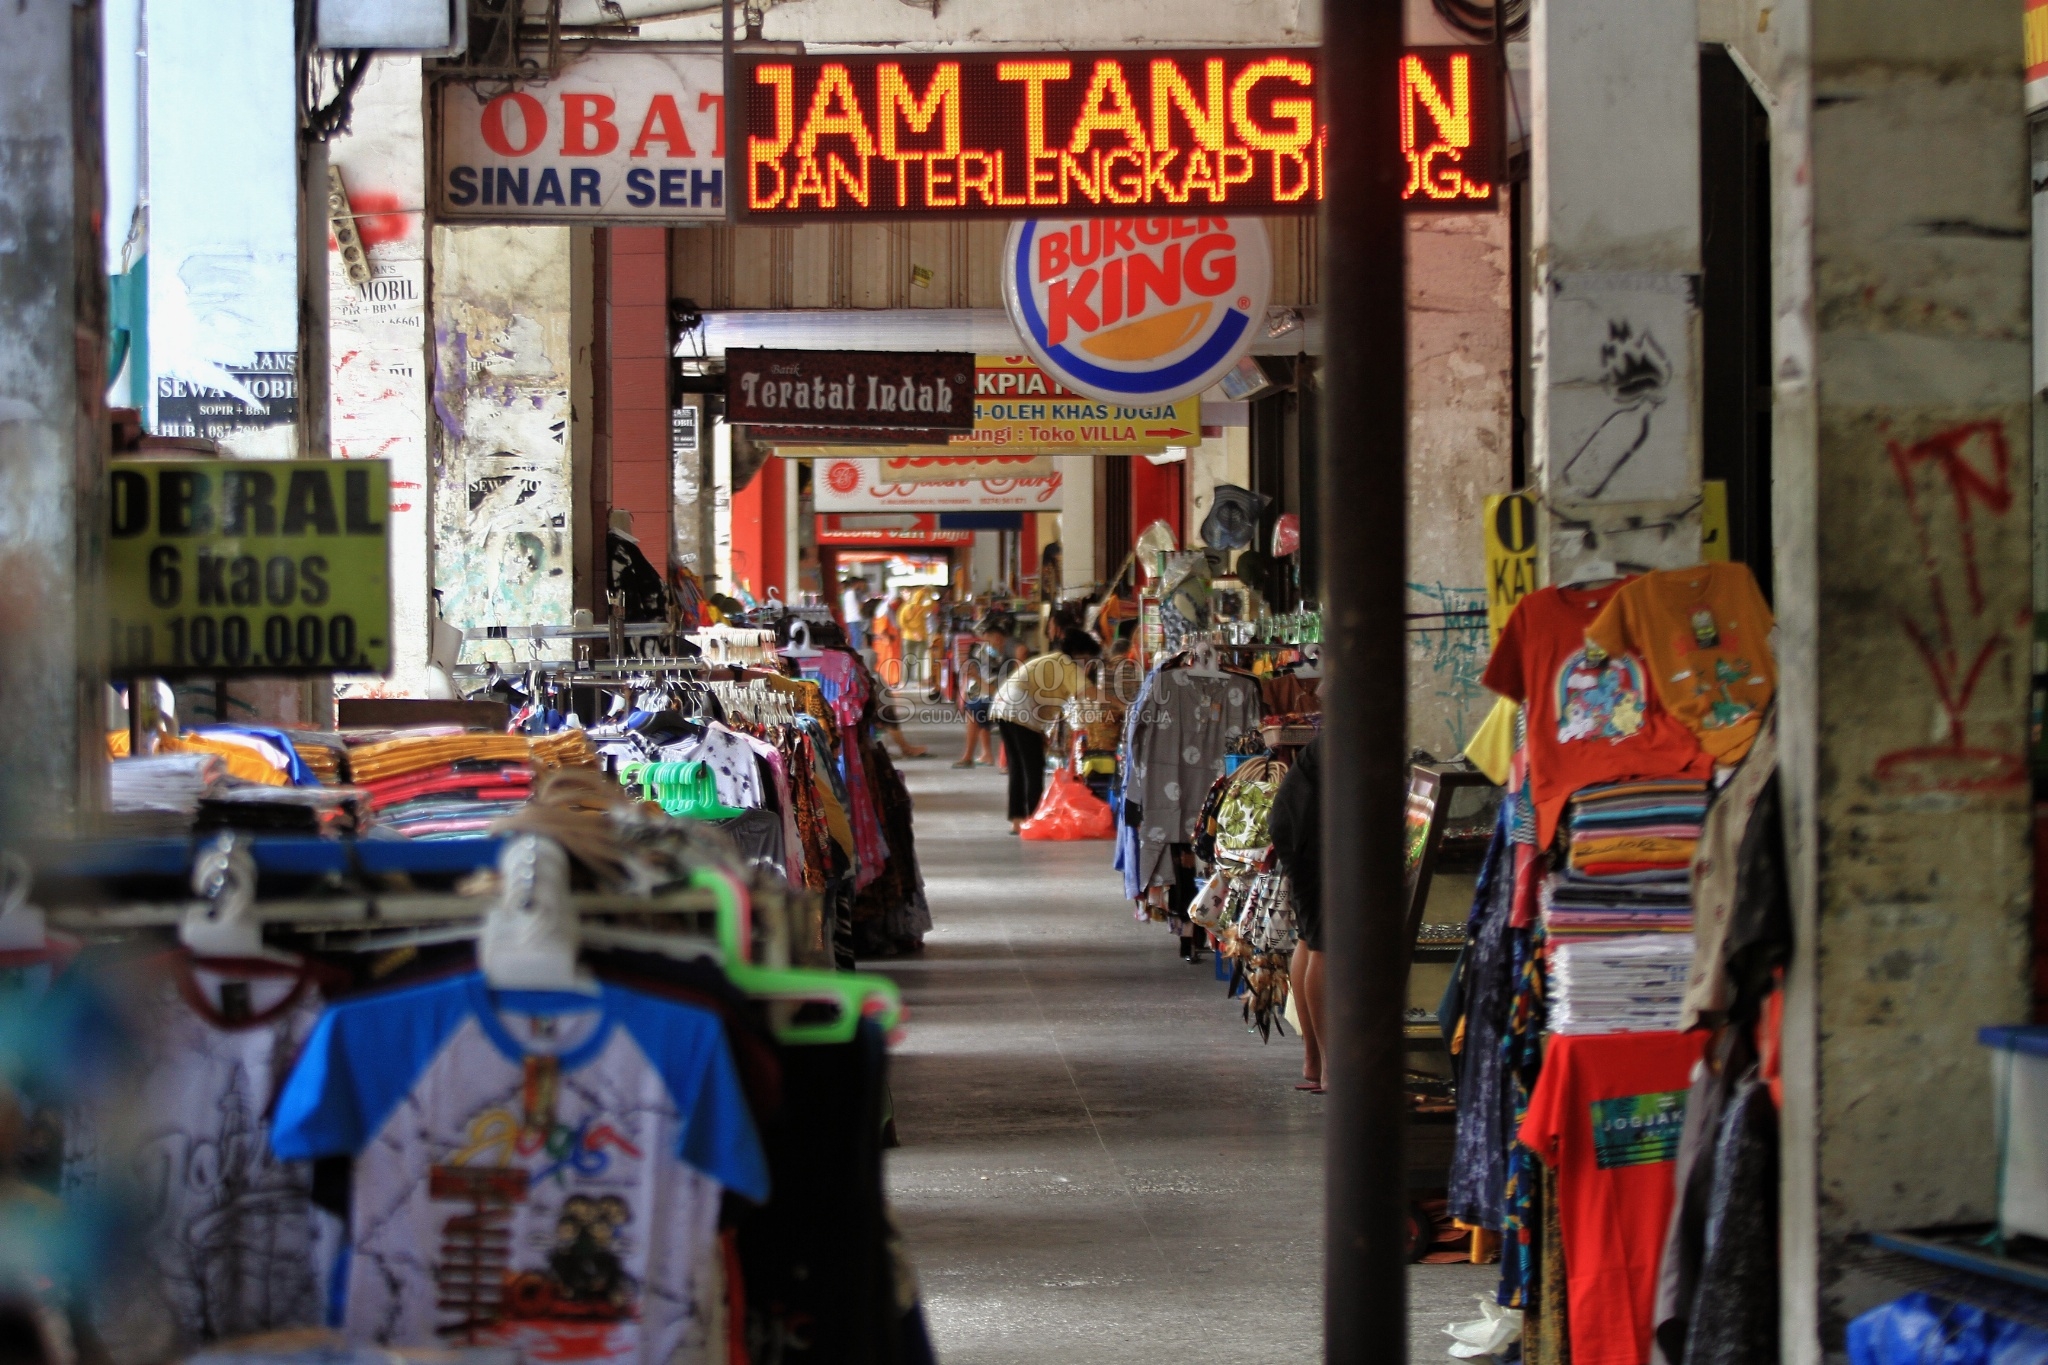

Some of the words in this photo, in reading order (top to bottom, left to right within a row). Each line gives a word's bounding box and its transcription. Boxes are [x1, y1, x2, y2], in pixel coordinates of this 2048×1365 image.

[480, 90, 726, 158] OBAT
[756, 62, 960, 160] JAM
[997, 54, 1470, 154] TANGN
[448, 165, 603, 208] SINAR
[748, 150, 869, 209] DAN
[886, 146, 1254, 207] TERLENGKAP
[1047, 233, 1237, 347] KING
[770, 363, 802, 377] Batik
[976, 373, 1047, 395] KPIA
[199, 405, 234, 416] SOPIR
[740, 372, 856, 411] Teratai
[867, 376, 953, 414] Indah
[1052, 404, 1109, 420] KHAS
[1029, 426, 1076, 442] Toko
[1080, 426, 1137, 441] VILLA
[148, 544, 183, 609] 6
[198, 546, 330, 608] kaos
